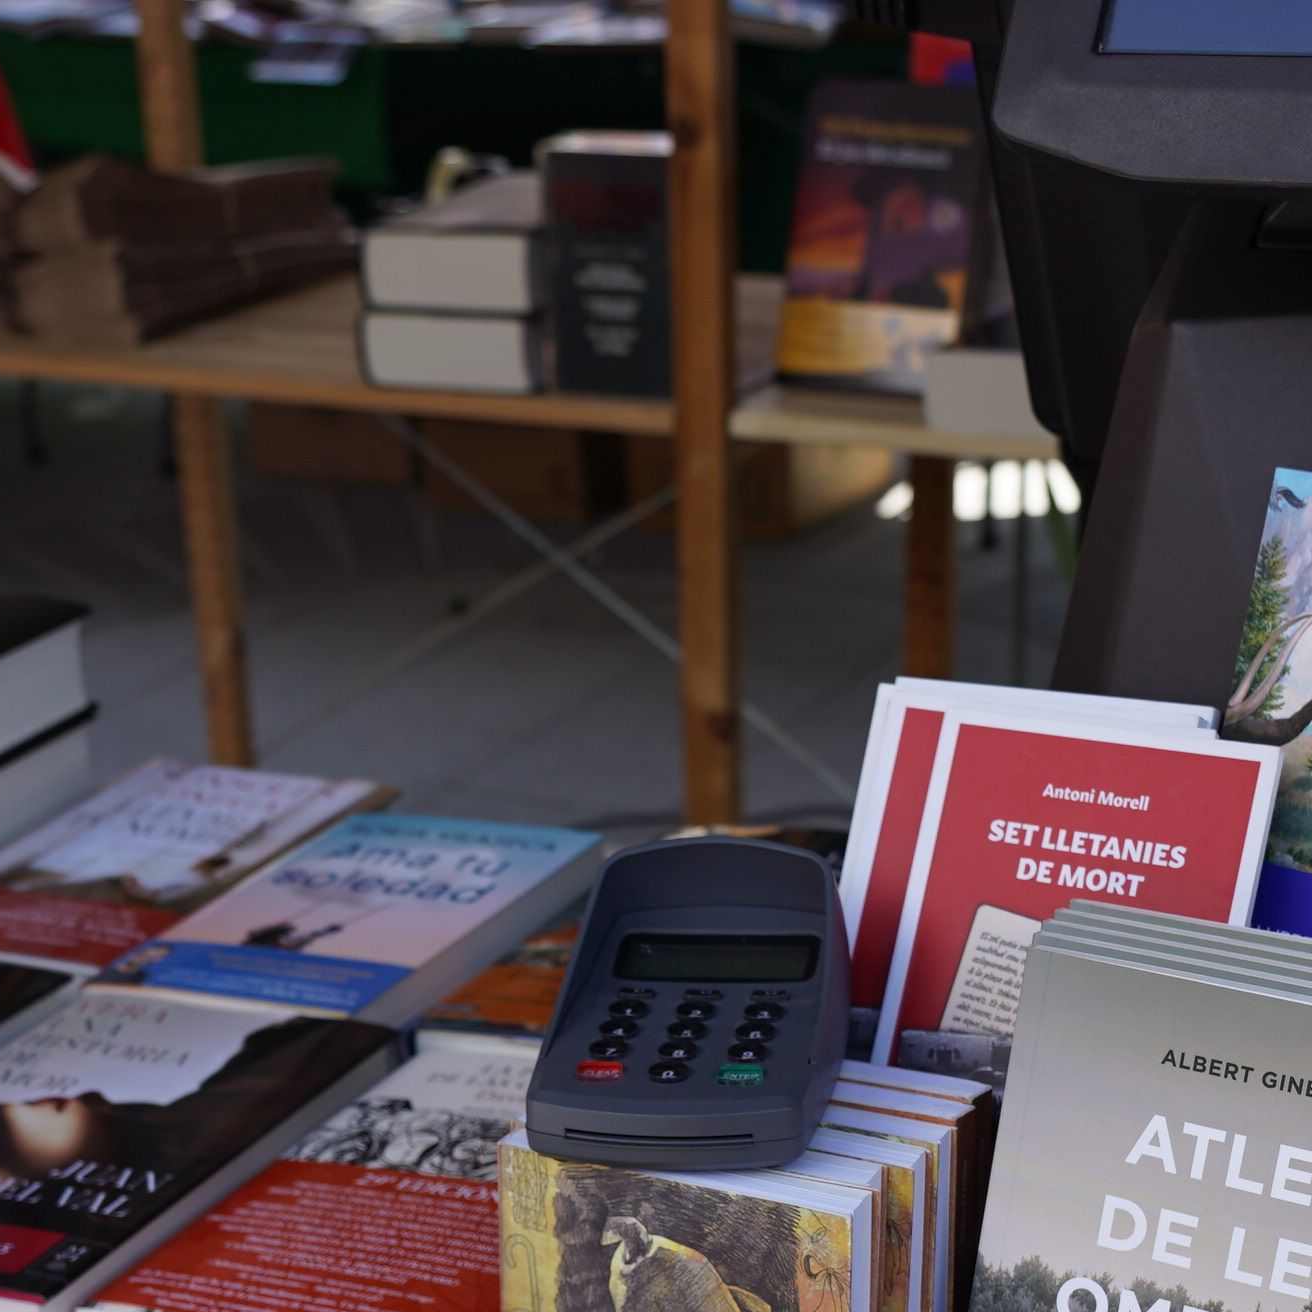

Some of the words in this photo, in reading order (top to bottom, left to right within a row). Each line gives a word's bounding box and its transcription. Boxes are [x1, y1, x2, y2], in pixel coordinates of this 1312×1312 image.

[1043, 783, 1095, 804] Antoni
[1097, 790, 1150, 811] Morell
[987, 819, 1040, 847] SET
[1041, 827, 1187, 869] LLETANIES
[1016, 857, 1055, 883] DE
[1058, 863, 1145, 897] MORT
[1160, 1048, 1255, 1085] ALBERT
[1096, 1194, 1200, 1271] DE
